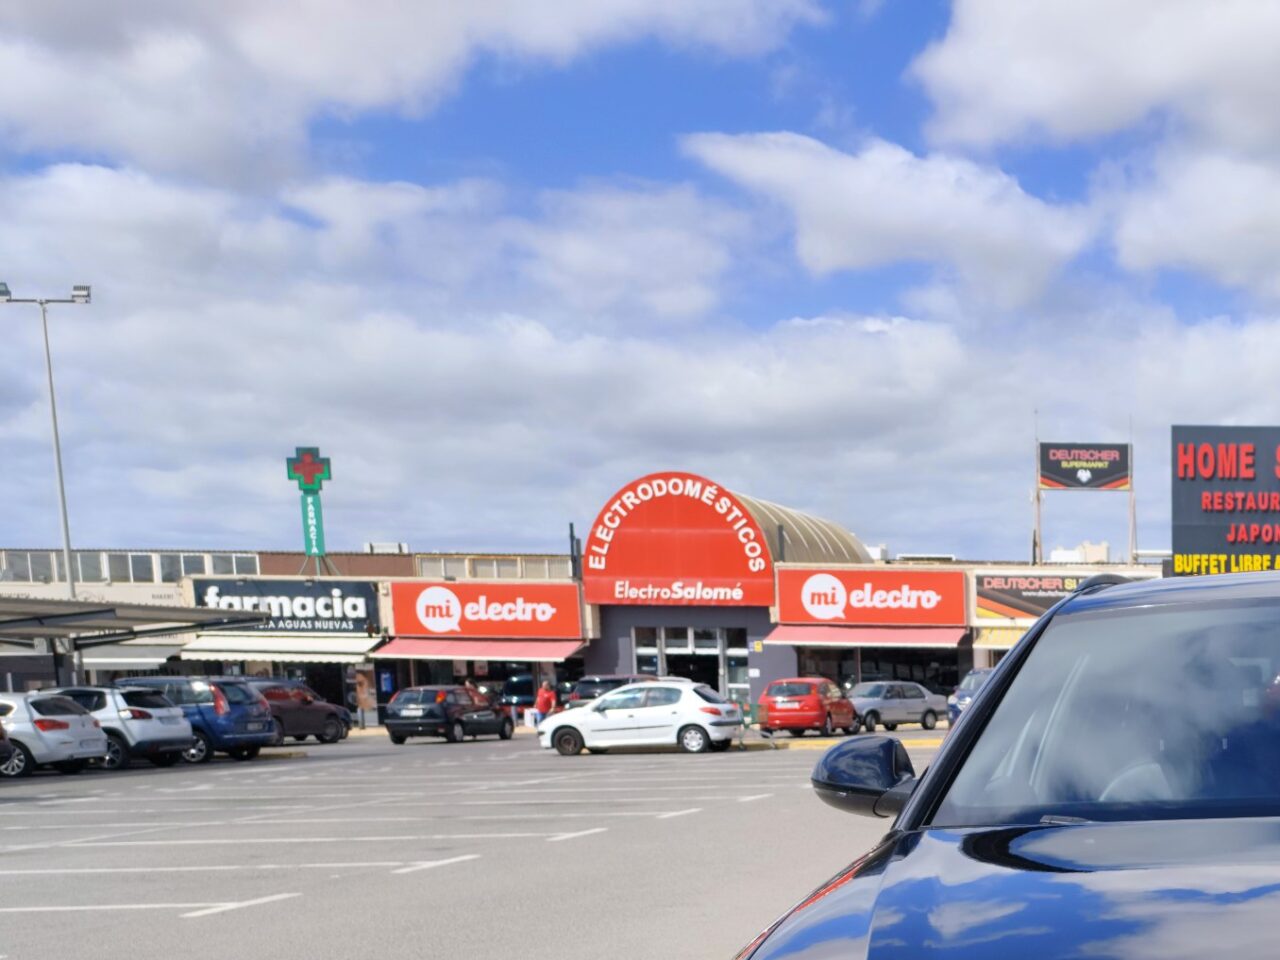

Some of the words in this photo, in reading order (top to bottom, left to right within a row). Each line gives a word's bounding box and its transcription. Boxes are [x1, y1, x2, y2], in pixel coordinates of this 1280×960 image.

[1049, 449, 1119, 460] DEUTSCHER
[1177, 442, 1255, 479] HOME
[307, 496, 319, 554] FARMACIA
[589, 478, 766, 573] ELECTRODOMÉSTICOS
[1174, 554, 1227, 574] BUFFET
[615, 581, 744, 600] ElectroSalomé
[811, 588, 839, 606] mi
[849, 583, 942, 609] electro
[983, 577, 1062, 589] DEUTSCHER
[204, 586, 367, 618] farmacia
[425, 600, 453, 619] mi
[464, 595, 556, 621] electro
[278, 619, 312, 630] AGUAS
[314, 619, 354, 630] NUEVAS
